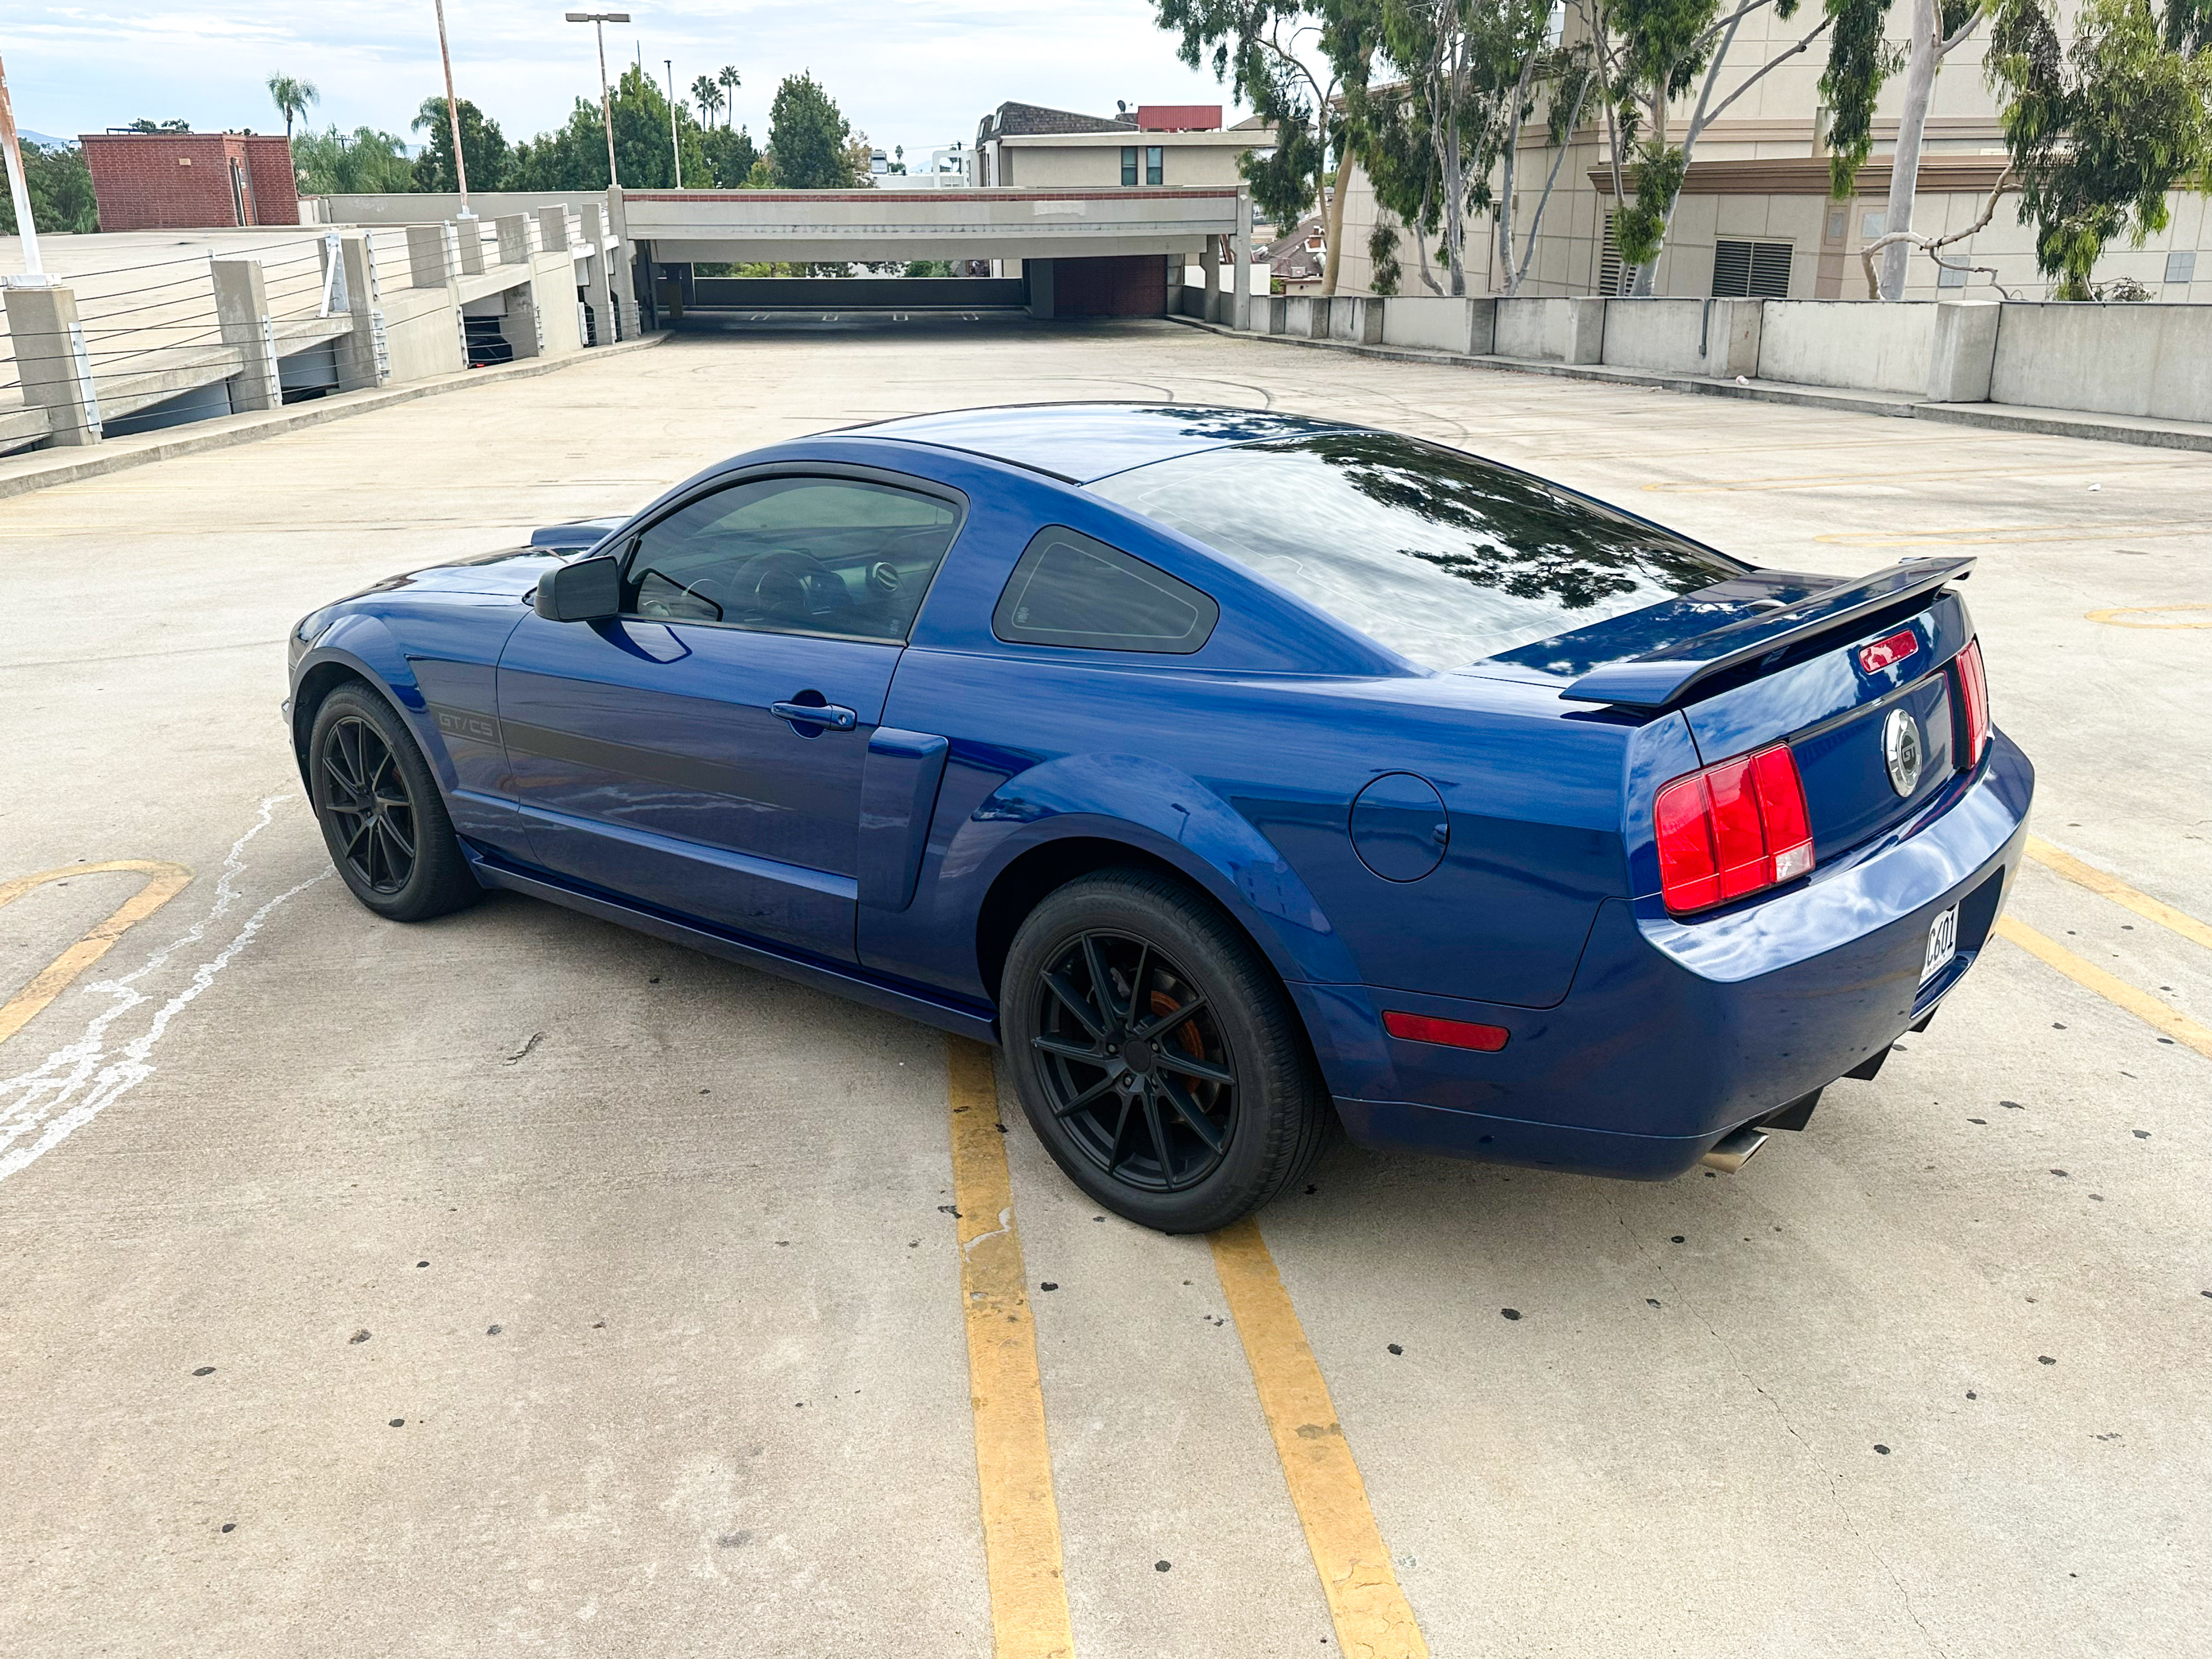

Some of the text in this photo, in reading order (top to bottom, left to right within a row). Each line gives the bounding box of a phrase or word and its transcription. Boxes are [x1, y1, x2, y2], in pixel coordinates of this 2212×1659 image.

[438, 712, 493, 737] GT/CS
[1902, 742, 1915, 763] GT
[1927, 911, 1955, 967] C601
